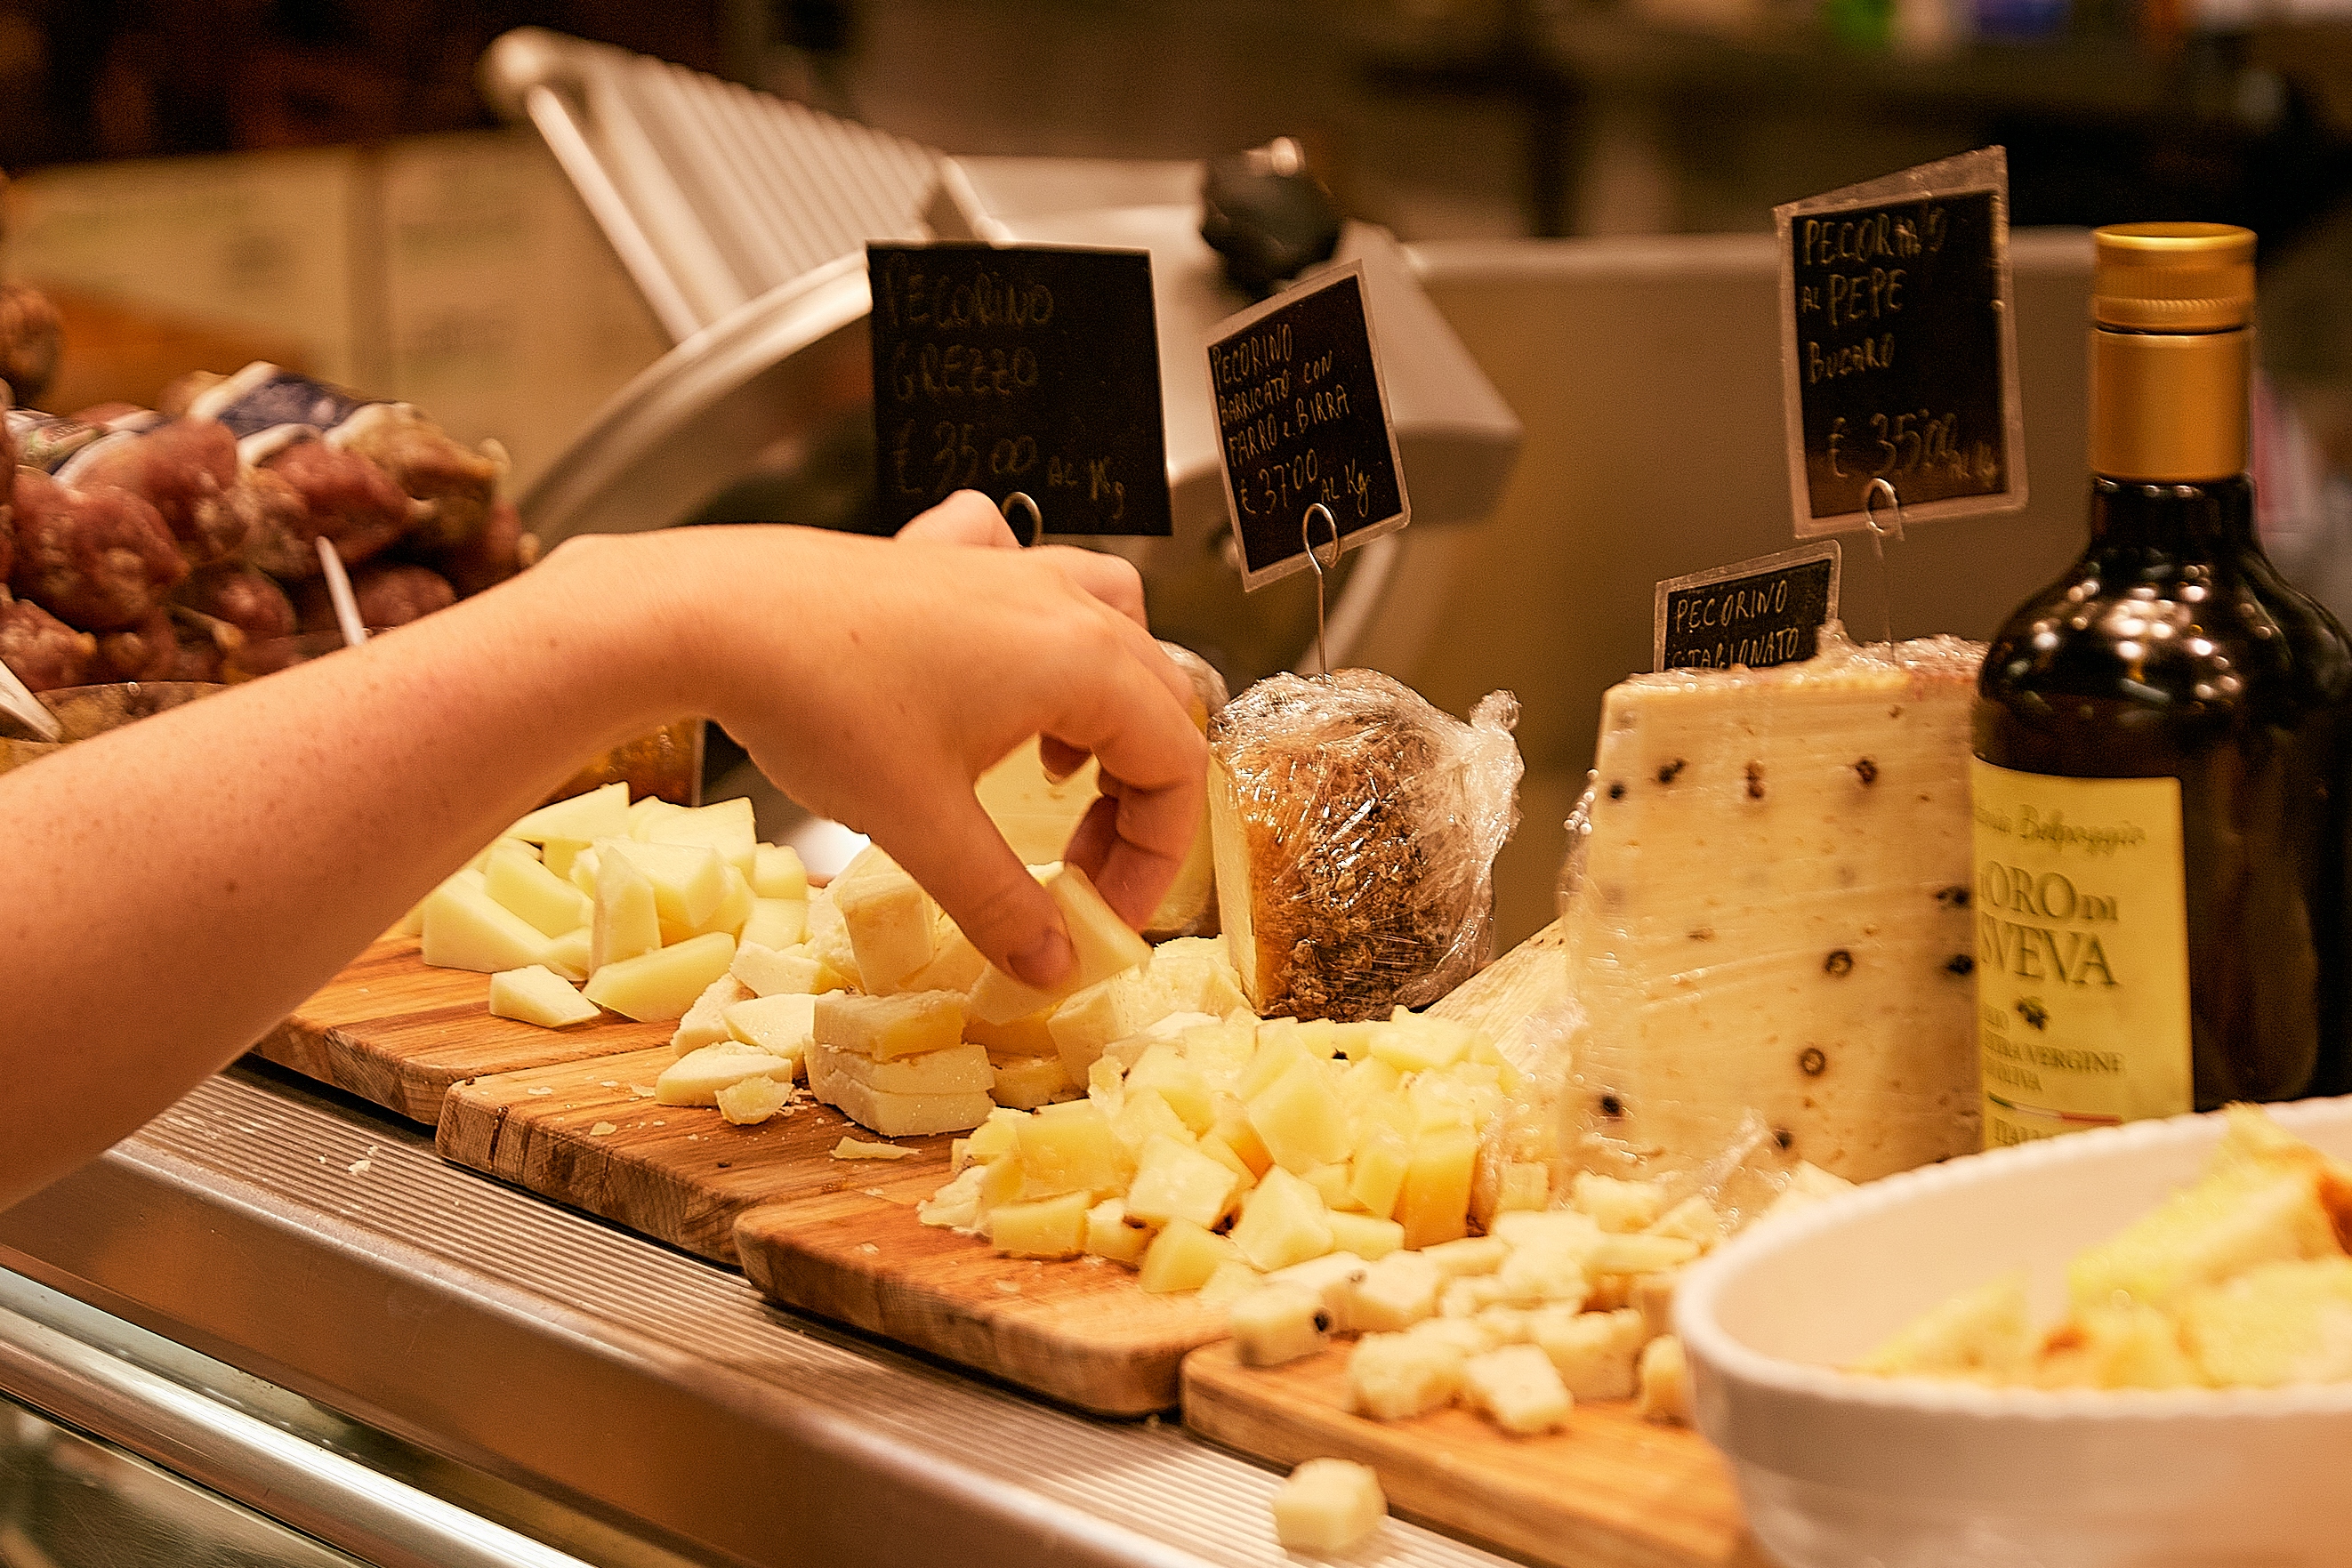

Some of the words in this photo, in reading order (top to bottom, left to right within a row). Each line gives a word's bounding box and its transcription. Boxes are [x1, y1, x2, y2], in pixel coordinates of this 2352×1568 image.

[1828, 267, 1907, 327] PEPE
[1212, 324, 1292, 391] PECORINO
[1219, 369, 1290, 426] BARRICATO
[1228, 413, 1277, 467] FARRO
[1297, 383, 1350, 434] BIRRA
[1240, 478, 1257, 514] €
[1676, 579, 1787, 634] PECORINO
[2022, 1042, 2125, 1073] VERGINE
